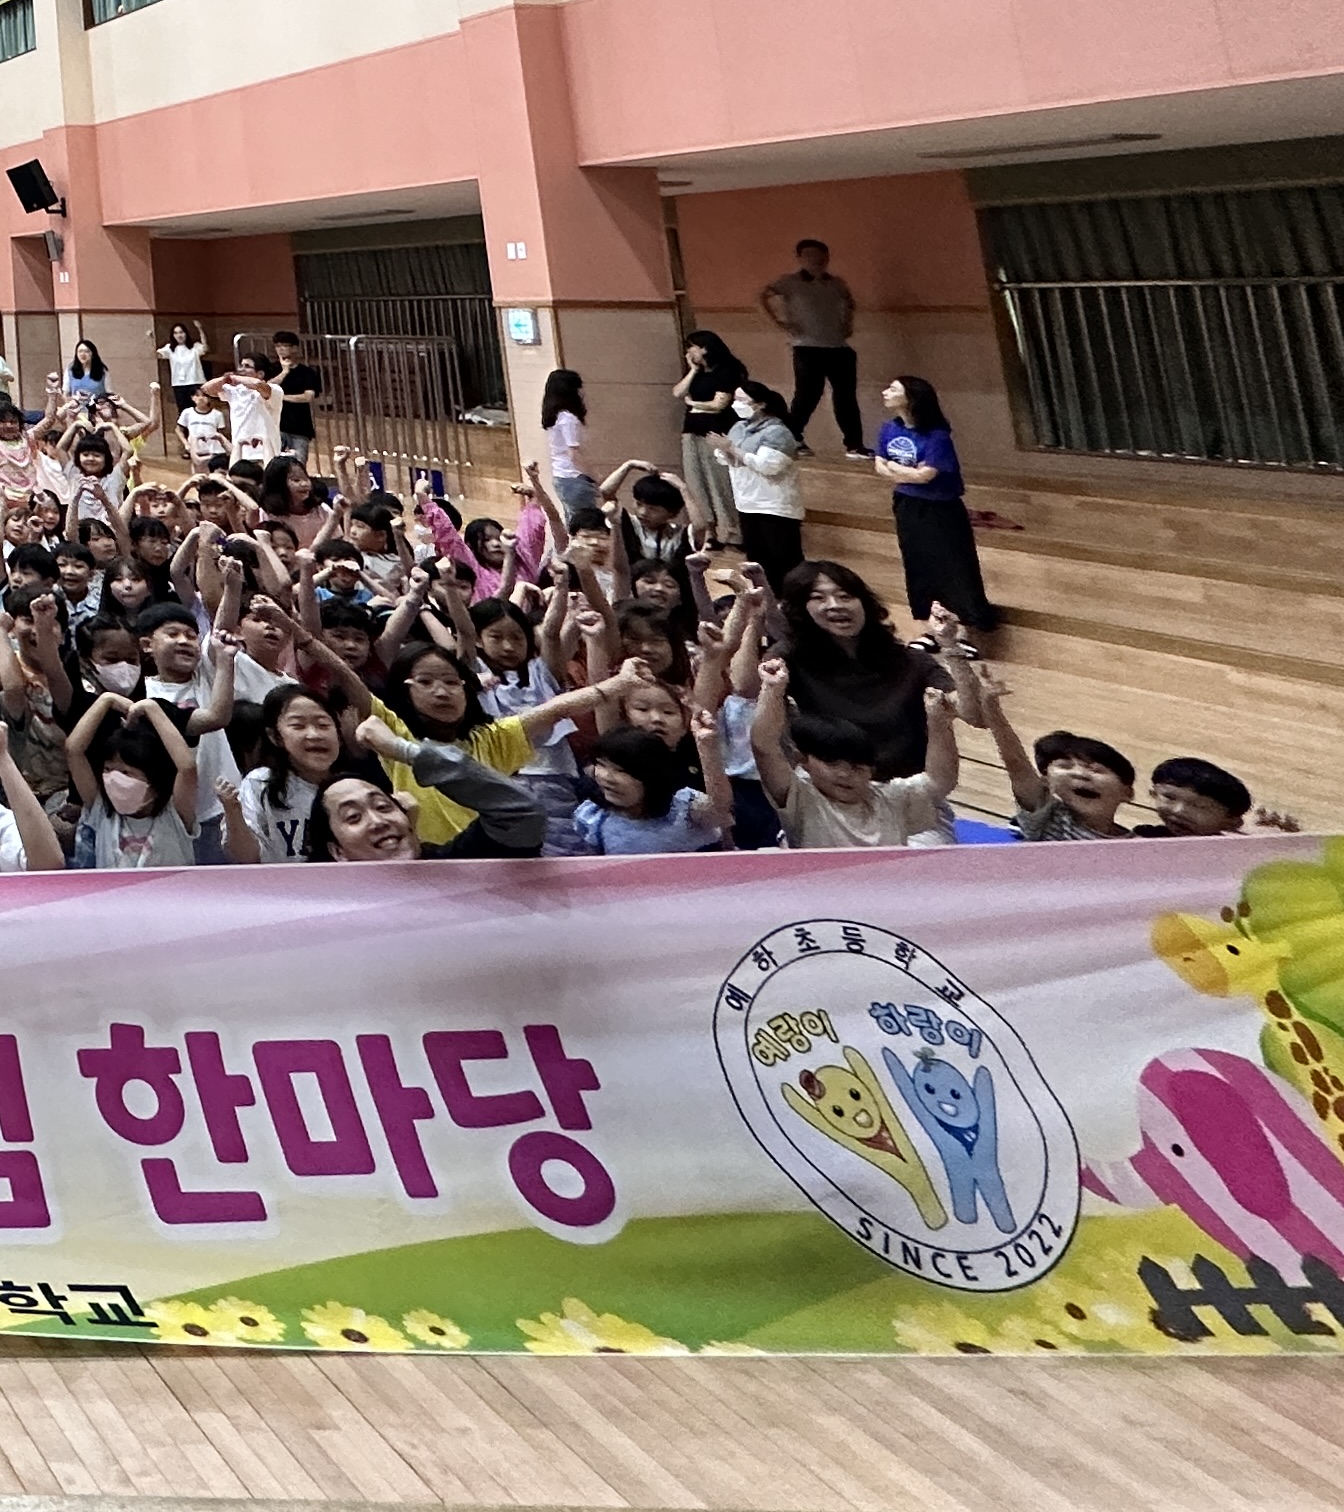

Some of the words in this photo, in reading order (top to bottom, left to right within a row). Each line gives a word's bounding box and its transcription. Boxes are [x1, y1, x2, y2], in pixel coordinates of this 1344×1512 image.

[723, 924, 967, 1012] 예하초등학교
[752, 1008, 840, 1067] 예랑이
[867, 1001, 984, 1060] 하랑이
[77, 1022, 618, 1227] 한마당
[855, 1216, 979, 1282] SINCE
[994, 1212, 1064, 1279] 2022
